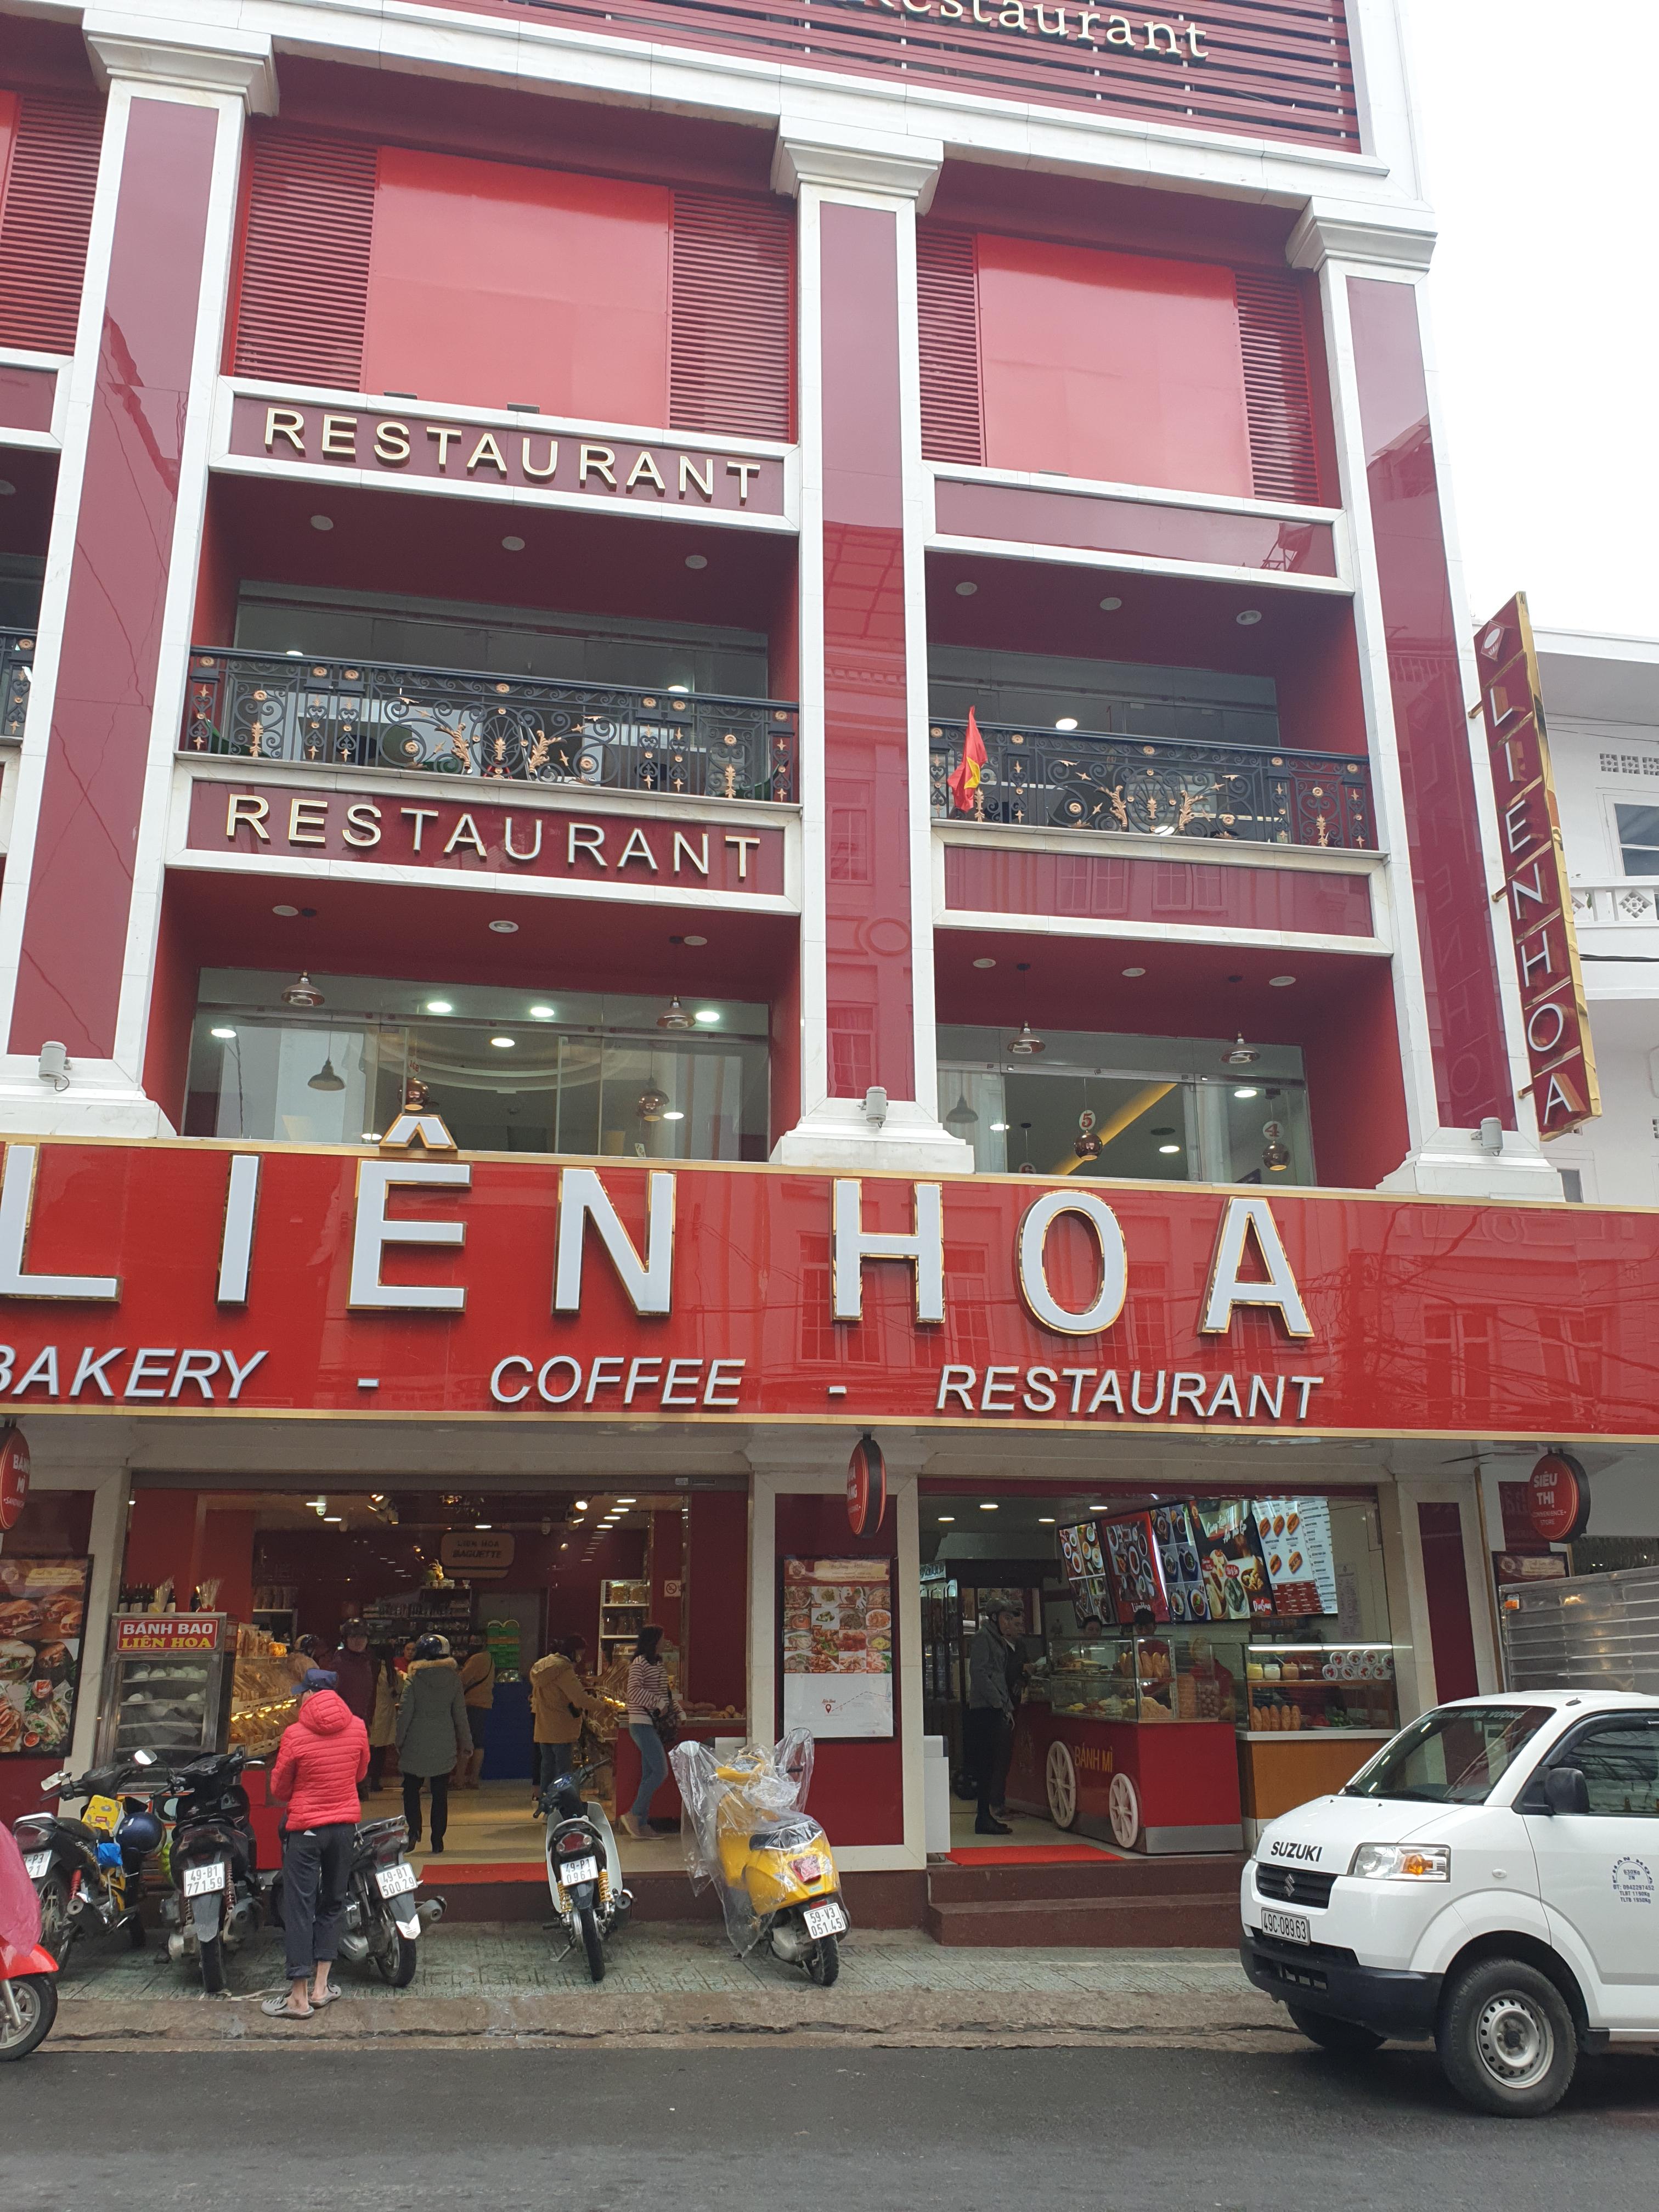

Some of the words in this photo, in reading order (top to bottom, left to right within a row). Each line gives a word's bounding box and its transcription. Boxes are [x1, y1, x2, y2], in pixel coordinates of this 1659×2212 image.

[849, 0, 1209, 57] staurant
[264, 407, 760, 505] RESTAURANT
[225, 793, 760, 878] RESTAURANT
[1081, 1113, 1092, 1128] 5
[1265, 1123, 1280, 1137] 4
[0, 1114, 677, 1316] LIÊN
[831, 1177, 1315, 1338] HOA
[490, 1355, 746, 1406] COFFEE
[935, 1364, 1324, 1420] RESTAURANT
[1536, 1491, 1554, 1508] THỊ
[123, 1622, 172, 1635] BÁNH
[177, 1623, 213, 1634] BAO
[122, 1635, 166, 1648] LIÊN
[171, 1637, 212, 1647] HOA
[1074, 1742, 1099, 1770] BÁNH
[1102, 1746, 1113, 1773] MÌ
[1271, 1841, 1323, 1862] SUZUKI
[191, 1865, 217, 1881] 49-B1
[382, 1866, 407, 1883] 49-B1
[566, 1859, 590, 1873] 49-P1
[566, 1869, 591, 1883] 0961
[187, 1877, 223, 1895] 771.59
[382, 1877, 415, 1896] 500.29
[810, 1908, 836, 1923] 59-V3
[811, 1917, 842, 1936] 051.45
[1263, 1912, 1306, 1940] 49C-089.63
